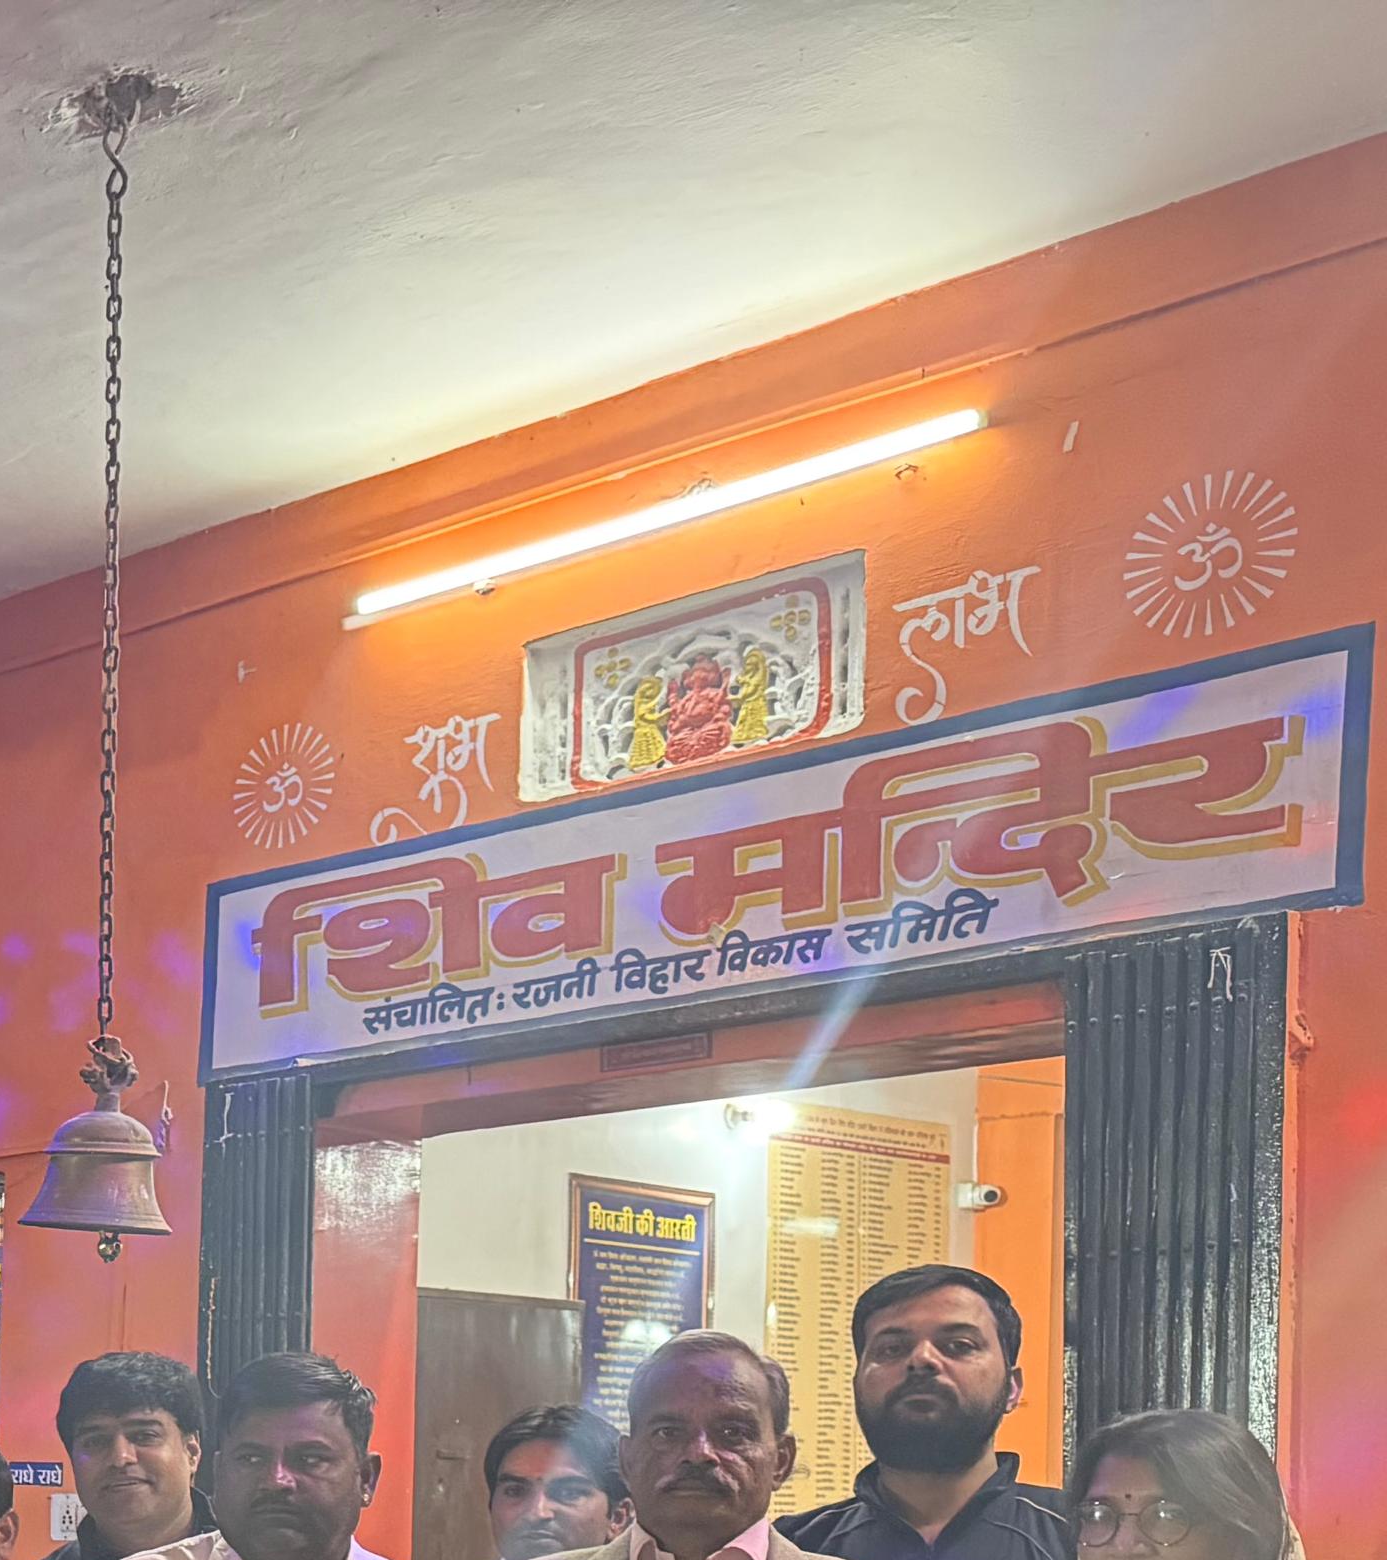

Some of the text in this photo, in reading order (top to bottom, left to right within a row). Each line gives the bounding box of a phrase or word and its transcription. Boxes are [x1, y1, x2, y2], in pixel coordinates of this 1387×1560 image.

[892, 566, 1041, 726] लाभ
[370, 713, 501, 846] शुभ
[253, 715, 1305, 1019] शिव मन्दिर
[511, 957, 601, 1011] रजनी
[613, 948, 705, 995] विहार
[716, 929, 831, 976] विकास
[844, 888, 999, 954] समिति
[589, 1202, 696, 1242] शिवजी की आरती
[10, 1464, 62, 1484] राधे राधे
